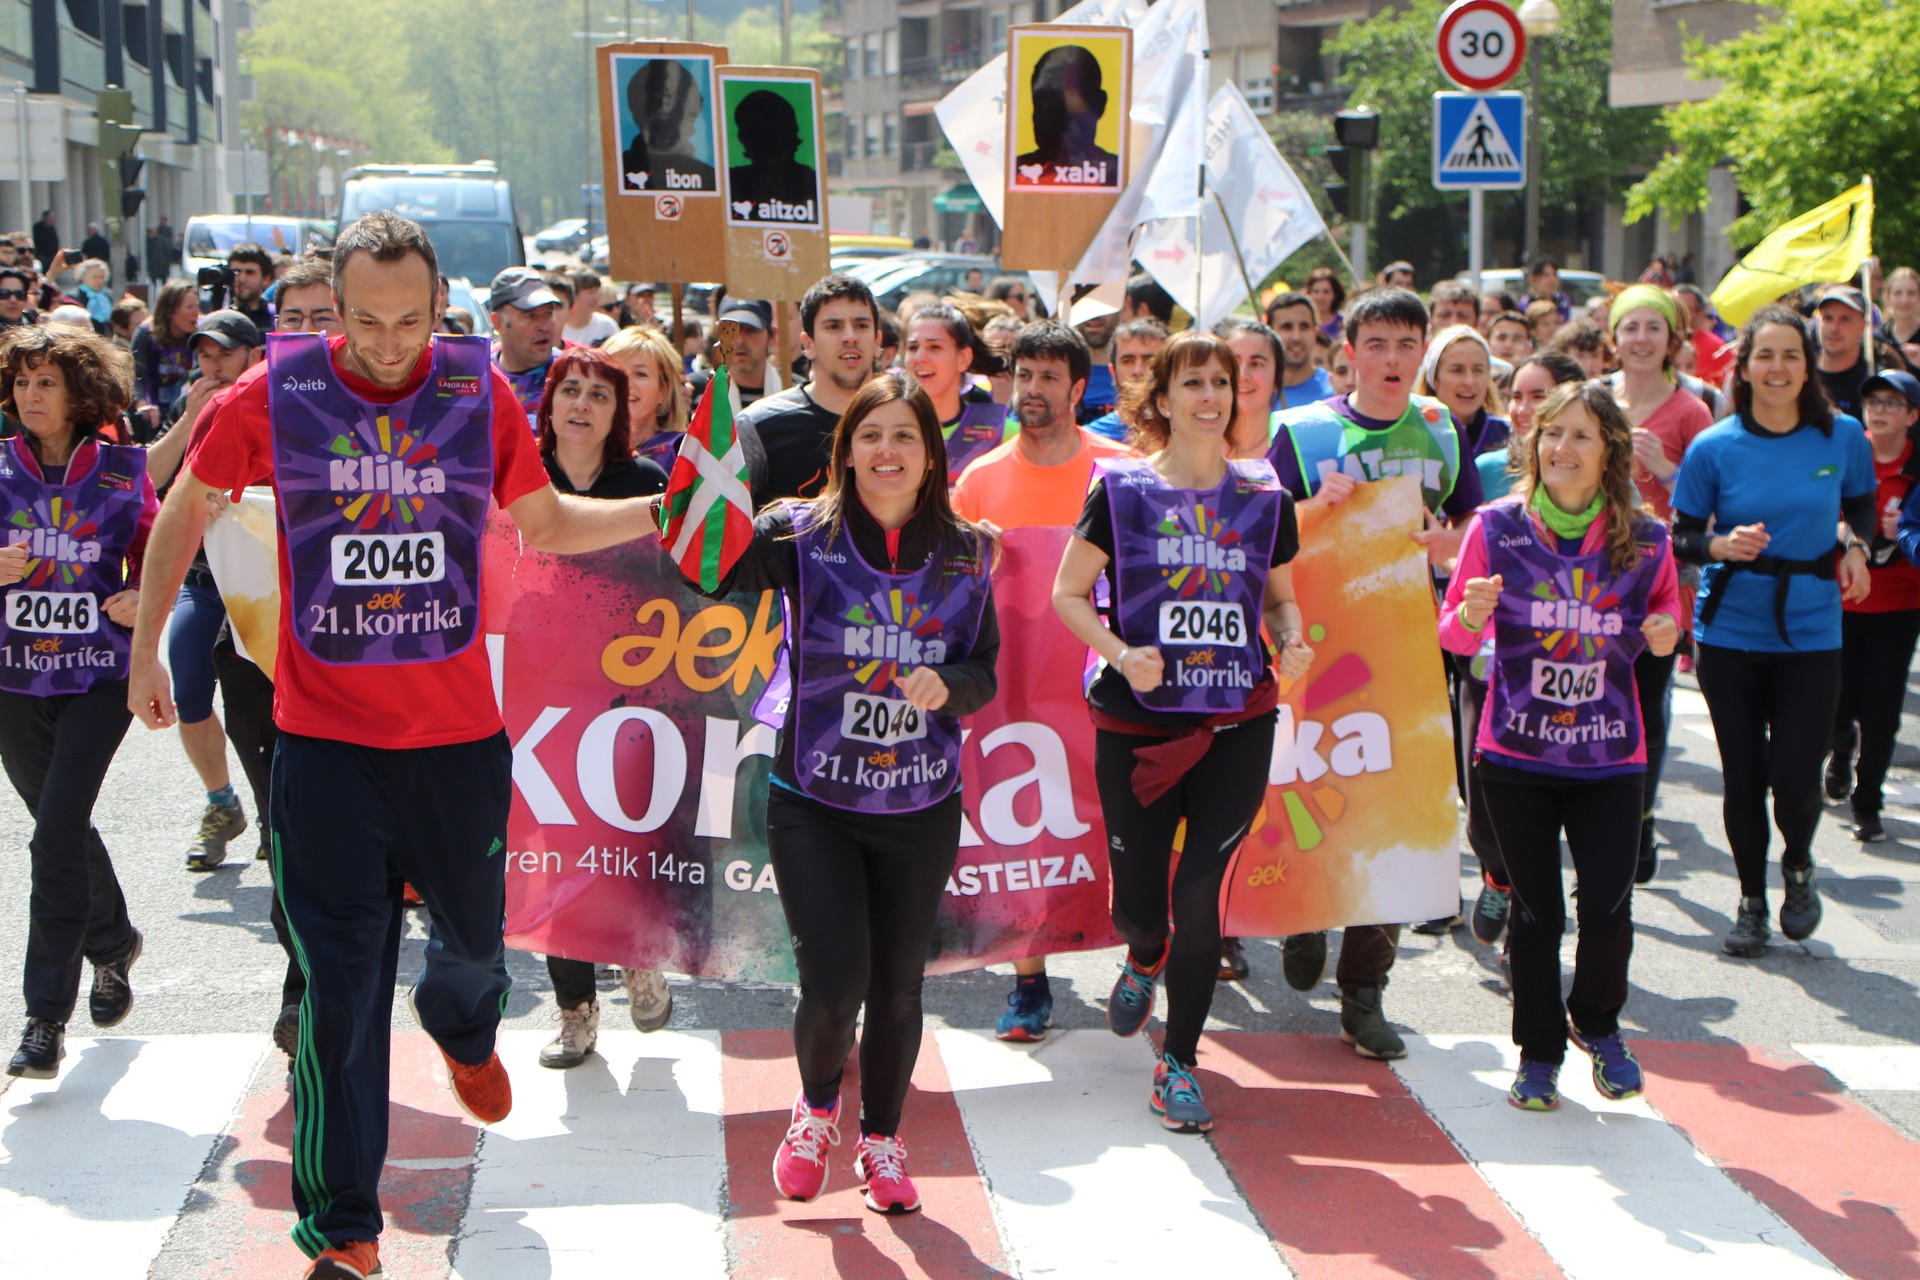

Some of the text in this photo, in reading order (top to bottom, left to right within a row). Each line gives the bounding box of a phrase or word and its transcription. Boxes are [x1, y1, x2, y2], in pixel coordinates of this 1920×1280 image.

[1461, 30, 1503, 57] 30
[665, 169, 702, 189] ibon
[1053, 161, 1106, 184] xabi
[758, 199, 814, 221] aitzol
[300, 378, 327, 391] eitb
[329, 454, 446, 495] Klika
[8, 526, 101, 563] Klika
[343, 538, 435, 579] 2046
[824, 552, 847, 564] eitb
[1157, 534, 1247, 572] Klika
[1510, 537, 1532, 547] eitb
[15, 594, 90, 630] 2046
[366, 586, 406, 611] aek
[310, 599, 463, 636] 21. korrika
[1168, 606, 1241, 642] 2046
[1531, 599, 1623, 636] Klika
[0, 645, 116, 673] 1. korrika
[32, 635, 63, 654] aek
[601, 588, 785, 695] aek
[844, 624, 947, 665] Klika
[1185, 646, 1217, 666] aek
[1176, 660, 1254, 688] korrika
[1540, 665, 1599, 700] 2046
[850, 699, 919, 740] 2046
[1504, 706, 1627, 746] 21. korrika
[812, 750, 948, 790] 21. korrika
[867, 746, 898, 768] aek
[576, 846, 639, 878] 4tik
[648, 851, 706, 885] 14ra
[1247, 857, 1288, 887] aek
